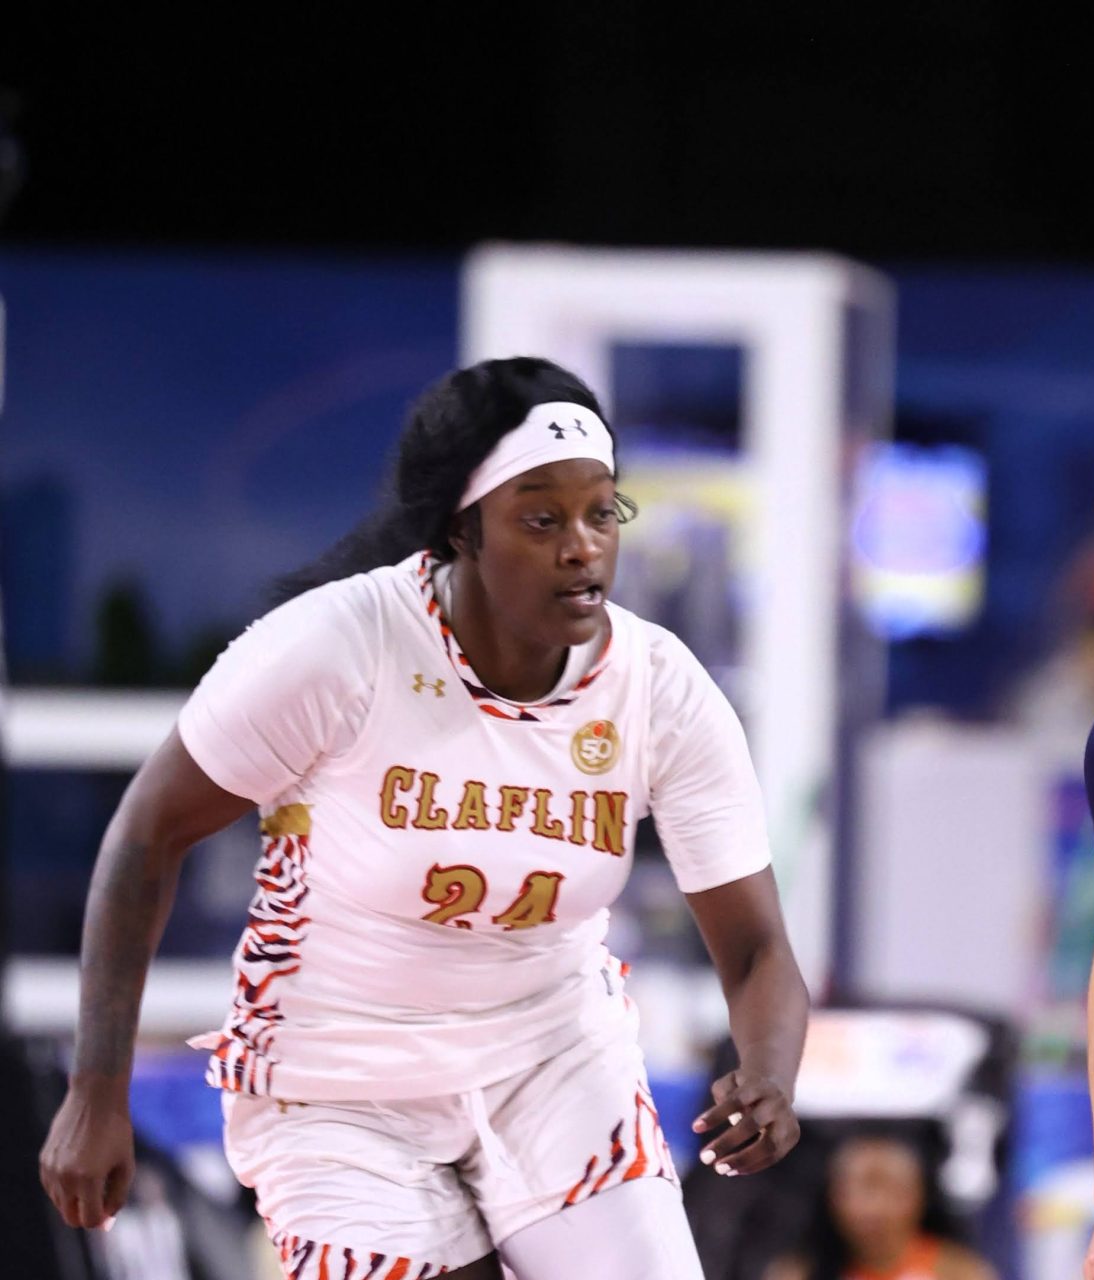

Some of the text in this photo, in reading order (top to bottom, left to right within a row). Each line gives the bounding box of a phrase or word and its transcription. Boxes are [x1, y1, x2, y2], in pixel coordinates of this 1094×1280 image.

[581, 738, 613, 762] 50
[379, 765, 628, 856] CLAFLIN
[421, 862, 566, 931] 24
